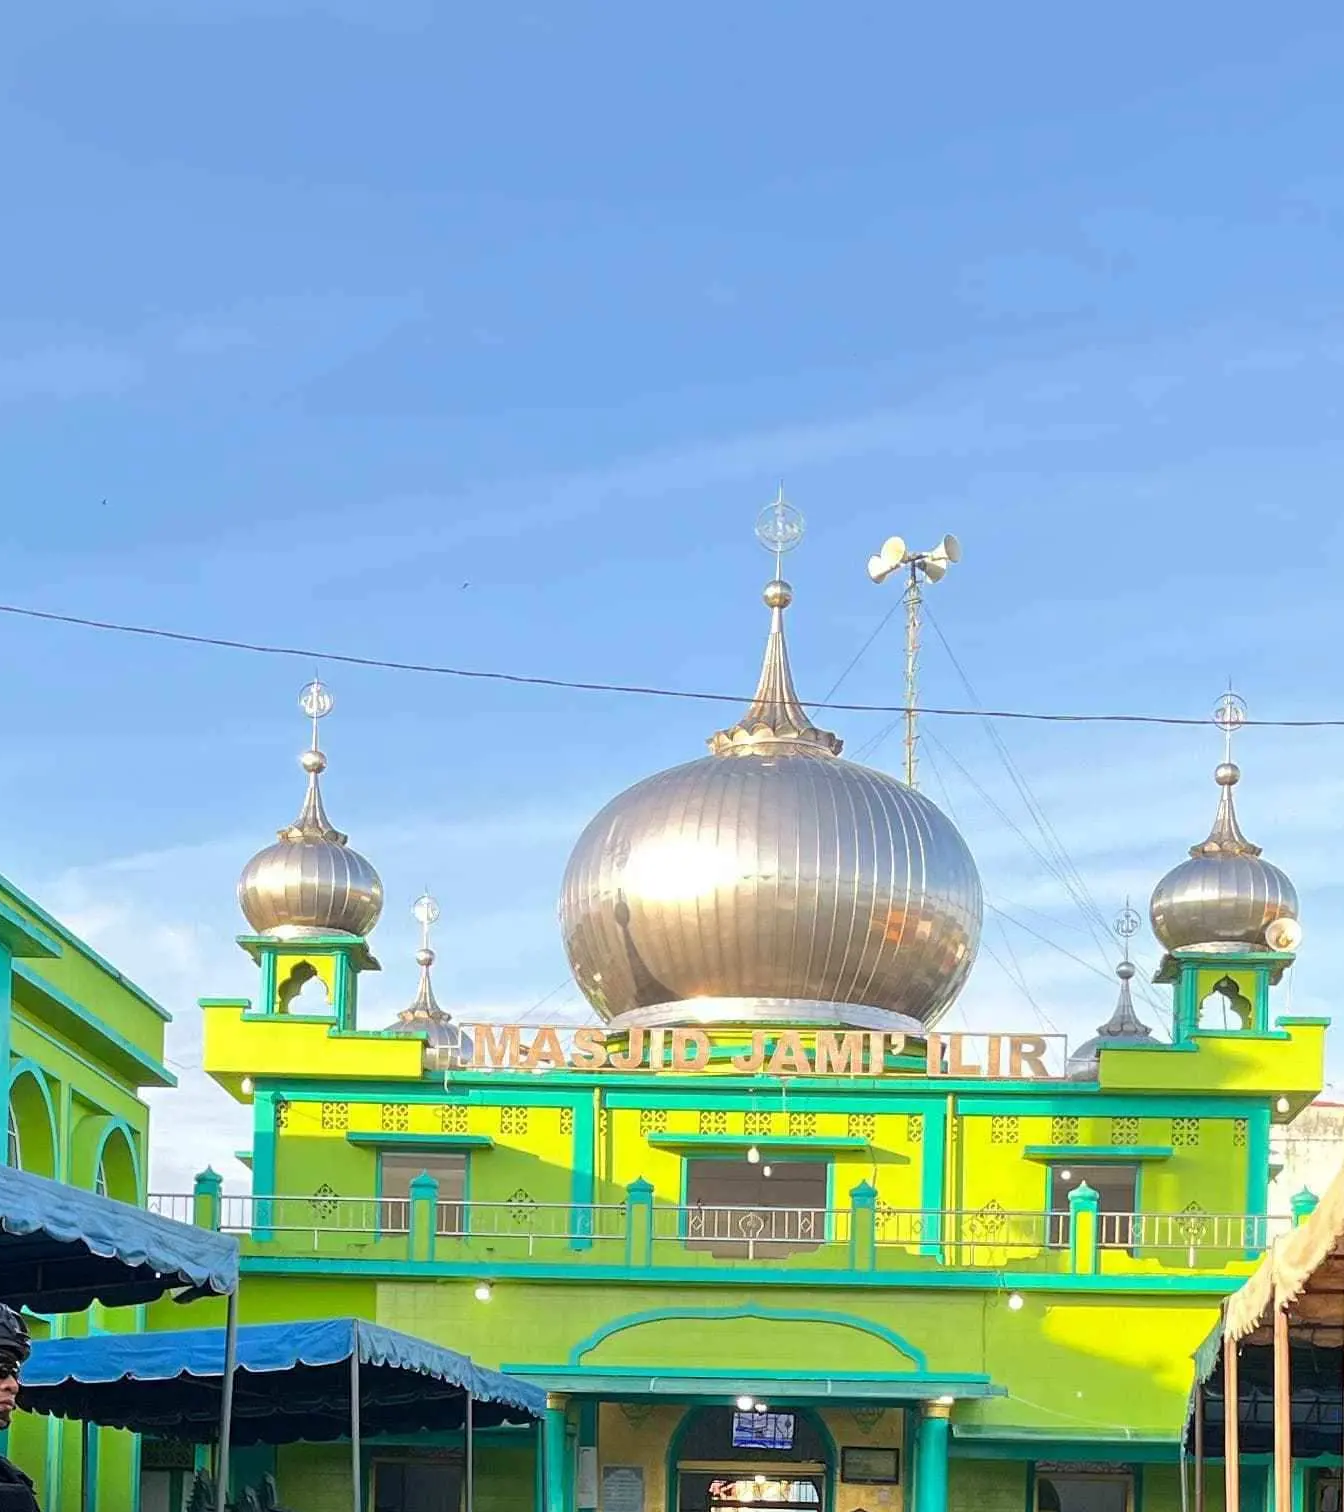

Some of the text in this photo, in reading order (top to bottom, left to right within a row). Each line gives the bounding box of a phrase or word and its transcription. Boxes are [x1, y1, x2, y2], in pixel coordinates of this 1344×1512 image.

[472, 1024, 1049, 1078] MASJID JAMI' ILIR
